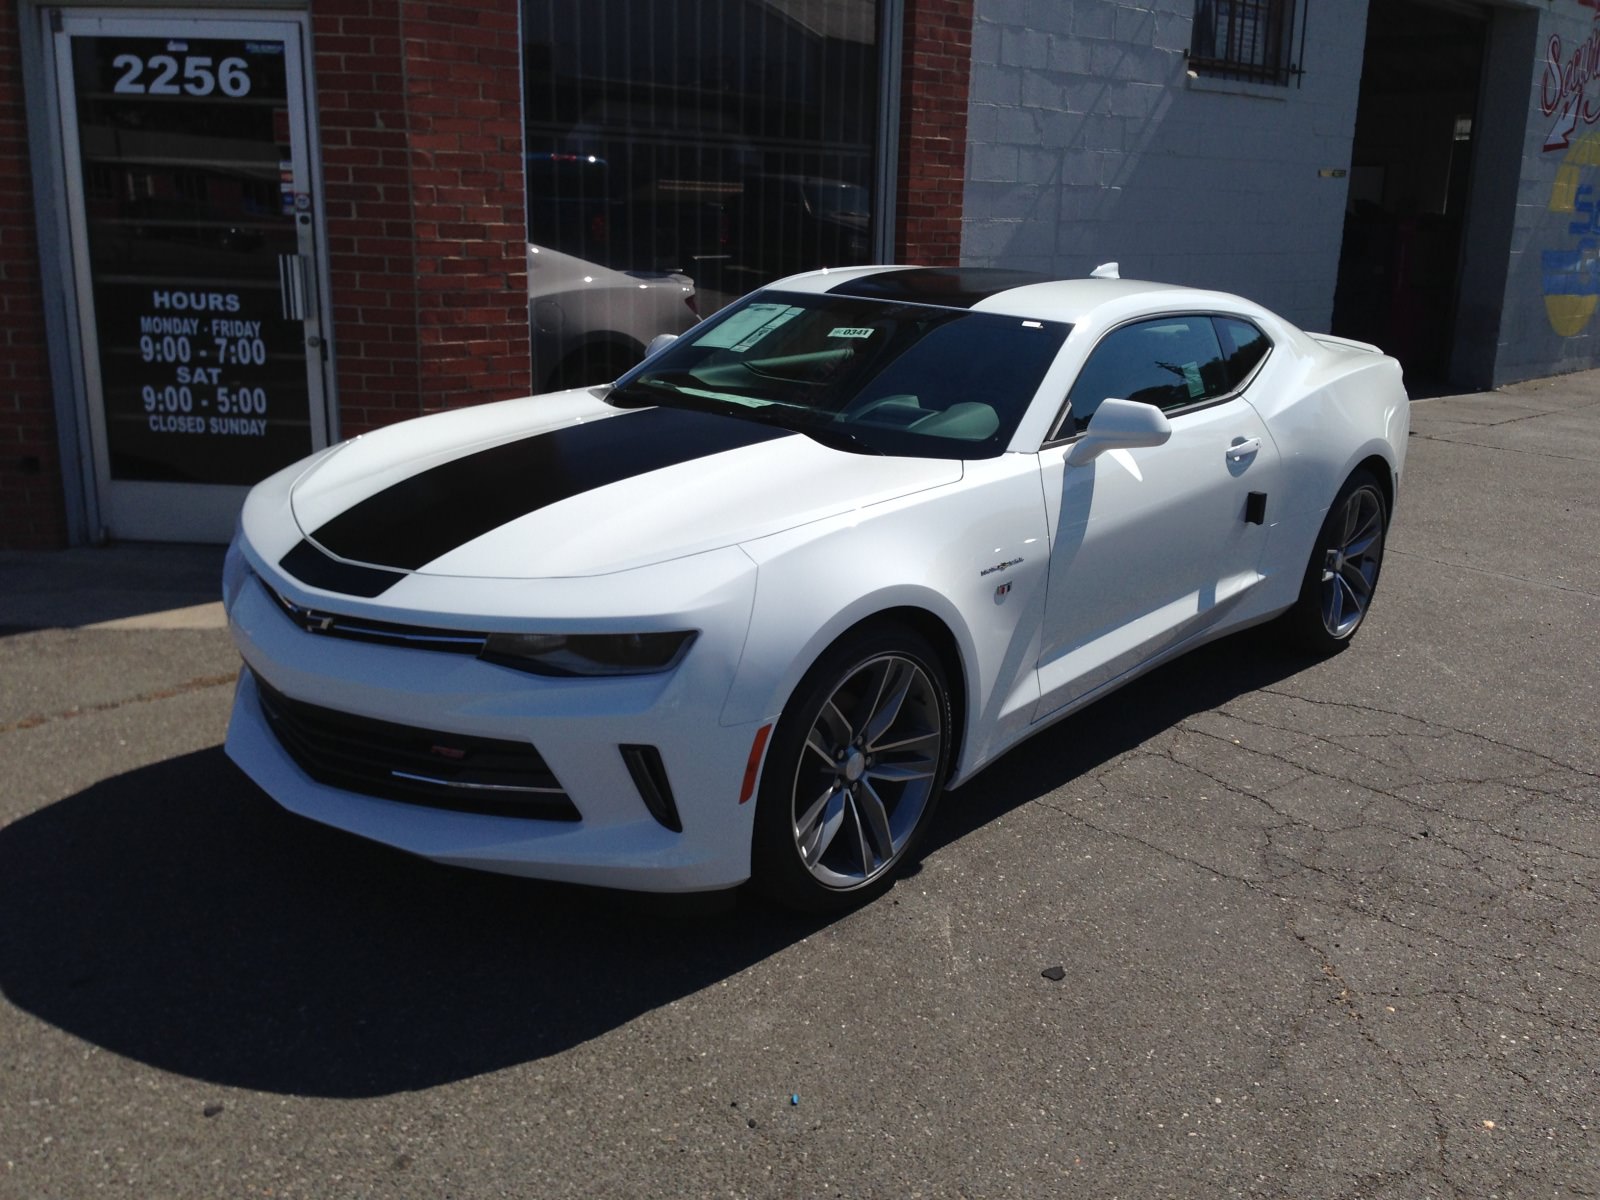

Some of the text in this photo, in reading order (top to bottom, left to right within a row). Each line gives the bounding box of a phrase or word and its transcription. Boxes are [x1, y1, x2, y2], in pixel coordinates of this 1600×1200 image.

[112, 54, 251, 97] 2256
[153, 290, 241, 312] HOURS
[140, 316, 199, 335] MONDAY
[212, 319, 261, 338] FRIDAY
[140, 335, 191, 363] 9:00
[214, 337, 266, 365] 7:00
[176, 366, 222, 385] SAT
[142, 385, 193, 413] 9:00
[217, 387, 267, 414] 5:00
[149, 414, 267, 436] CLOSED SUNDAY
